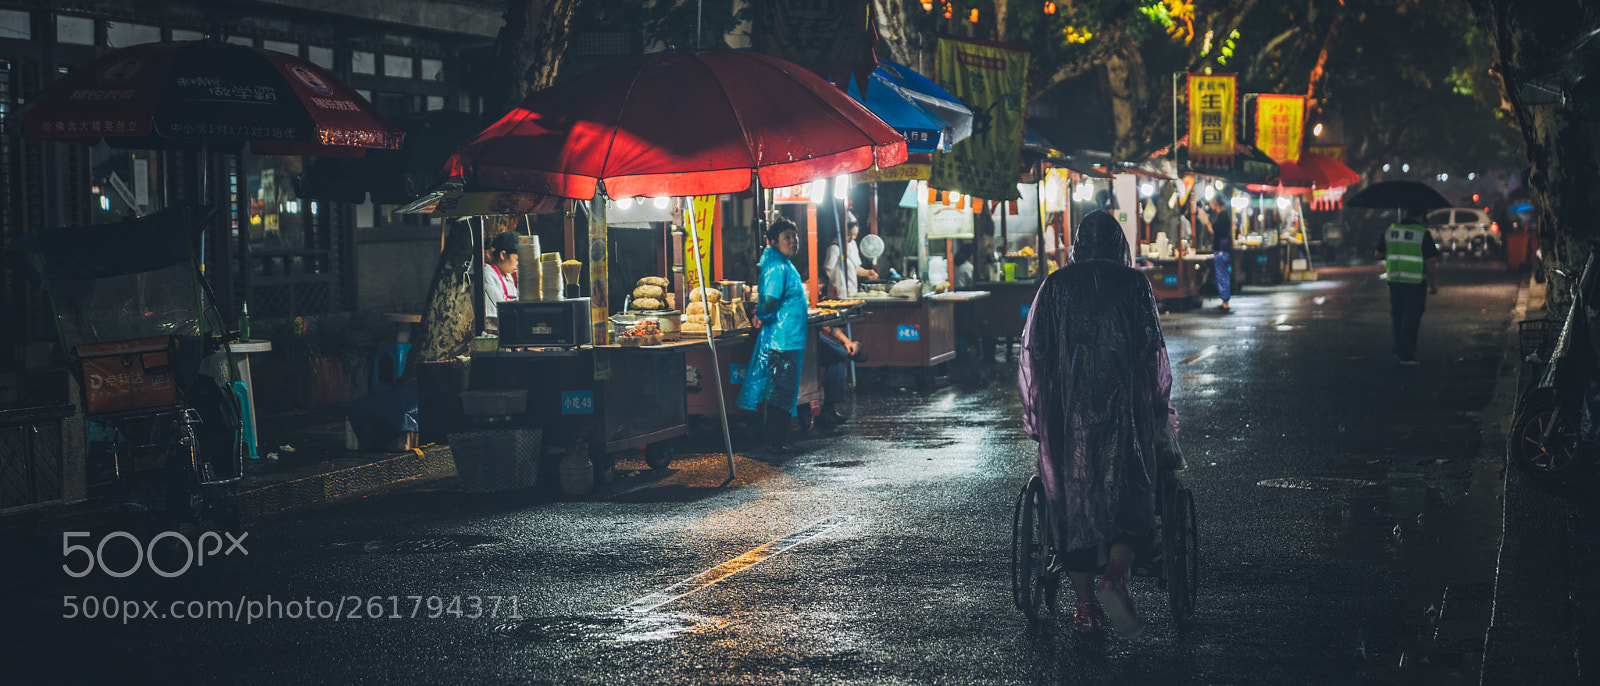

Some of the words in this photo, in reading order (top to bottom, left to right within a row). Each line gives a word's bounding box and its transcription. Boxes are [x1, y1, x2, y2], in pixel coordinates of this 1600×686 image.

[209, 85, 277, 101] 做学霸
[1200, 94, 1222, 144] 生煎包
[104, 373, 145, 387] 点我达
[564, 396, 581, 409] 小吃
[581, 397, 592, 408] 49
